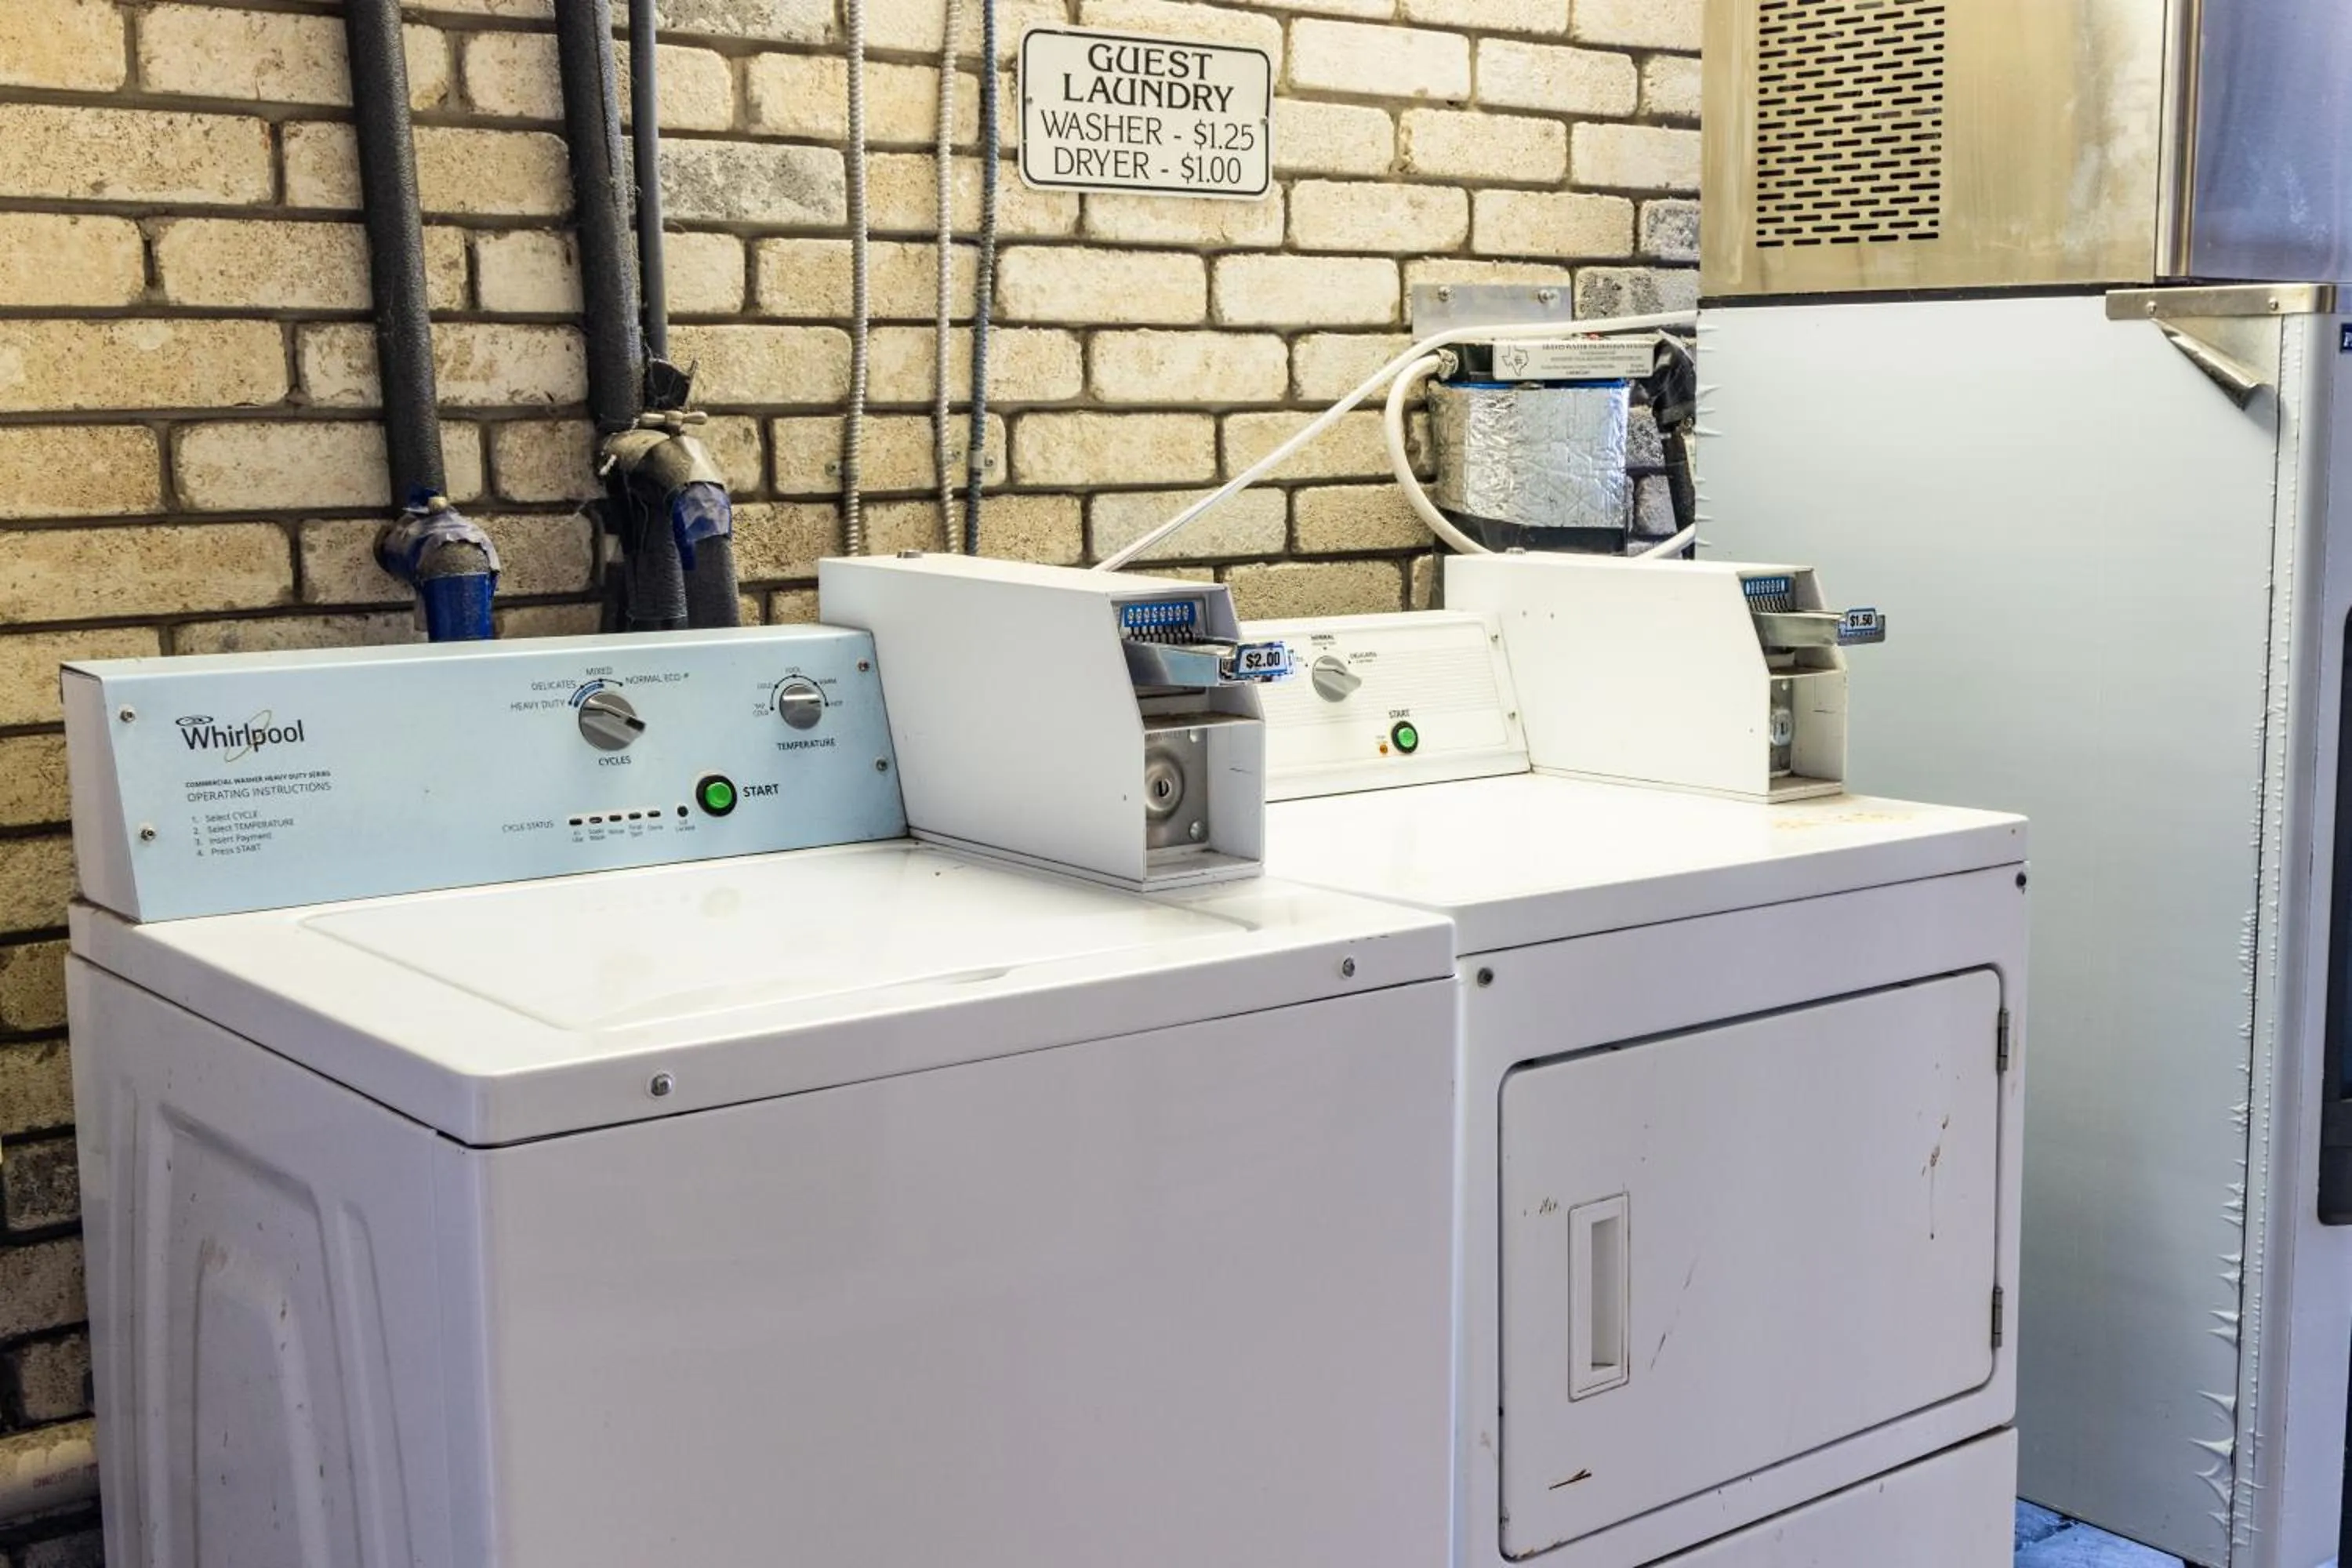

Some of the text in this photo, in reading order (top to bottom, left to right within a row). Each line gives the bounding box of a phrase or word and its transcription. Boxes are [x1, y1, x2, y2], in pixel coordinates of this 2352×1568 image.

[1087, 42, 1213, 80] GUEST
[1063, 73, 1234, 113] LAUNDRY
[1040, 109, 1163, 145] WASHER
[1193, 119, 1254, 151] $1.25
[1054, 147, 1150, 180] DRYER
[1181, 152, 1242, 184] $1.00
[1850, 614, 1874, 627] $1.50
[1245, 652, 1280, 669] $2.00
[586, 666, 613, 677] MIXED
[532, 680, 576, 691] DELICATES
[626, 674, 662, 684] NORMAL
[510, 699, 565, 710] HEAVY DUTY
[181, 719, 305, 753] Whirlpool
[777, 737, 836, 751] TEMPERATURE
[598, 756, 632, 767] CYCLES
[185, 779, 233, 788] COMMERCIAL
[234, 775, 263, 785] WASHER
[264, 773, 288, 782] HEAVY
[289, 771, 307, 781] DUTY
[187, 781, 332, 802] OPERATING INSTRUCTIONS
[742, 783, 779, 797] START
[205, 813, 230, 823] Select
[232, 810, 258, 821] CYCLE
[207, 824, 232, 833] Select
[234, 818, 294, 831] TEMPERATURE
[502, 819, 554, 833] CYCLE STATUS
[209, 835, 234, 845] Insert
[236, 832, 272, 843] Payment
[211, 848, 234, 856] Press
[236, 843, 261, 854] START
